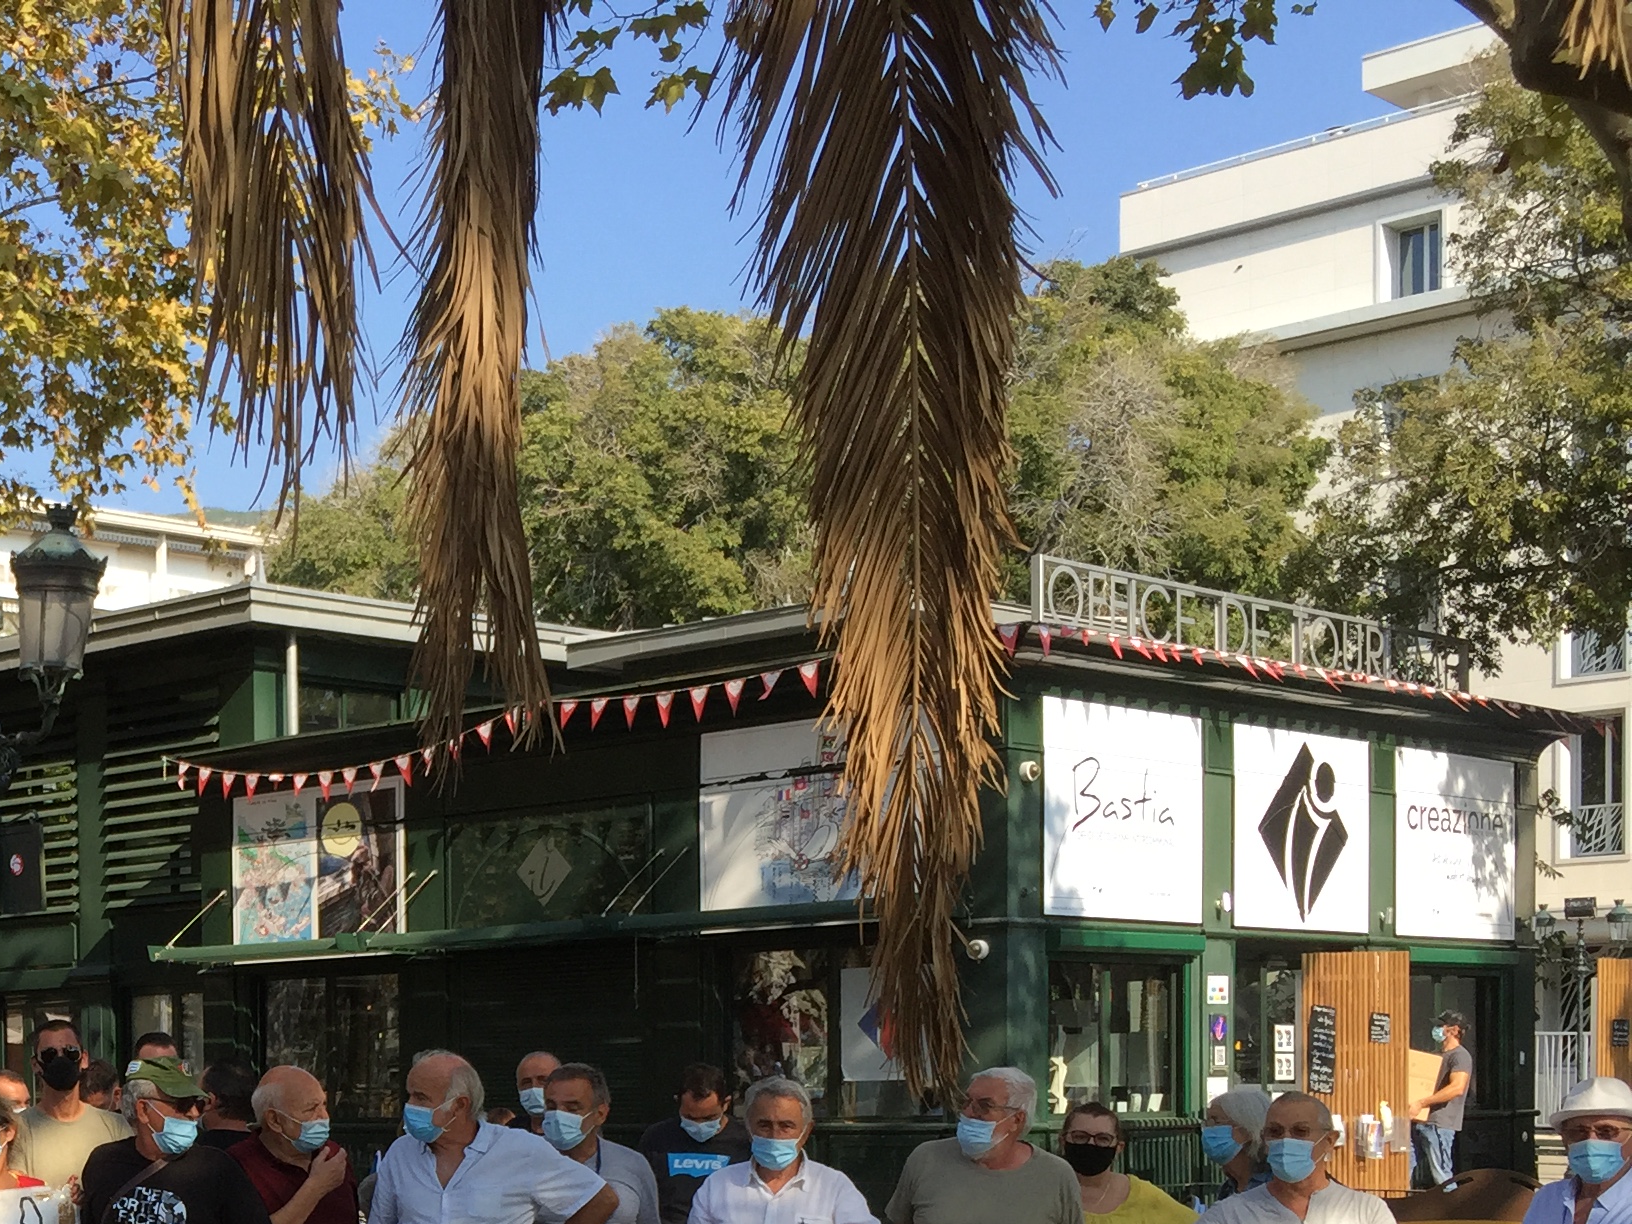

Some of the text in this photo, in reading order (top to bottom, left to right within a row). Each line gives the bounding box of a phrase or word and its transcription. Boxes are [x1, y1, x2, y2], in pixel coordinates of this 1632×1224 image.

[1047, 564, 1196, 646] OFFICE
[1222, 596, 1270, 658] DE
[1071, 757, 1175, 832] Bastia
[1406, 802, 1505, 836] creazione
[112, 1196, 160, 1215] ORTH
[134, 1186, 162, 1201] THE
